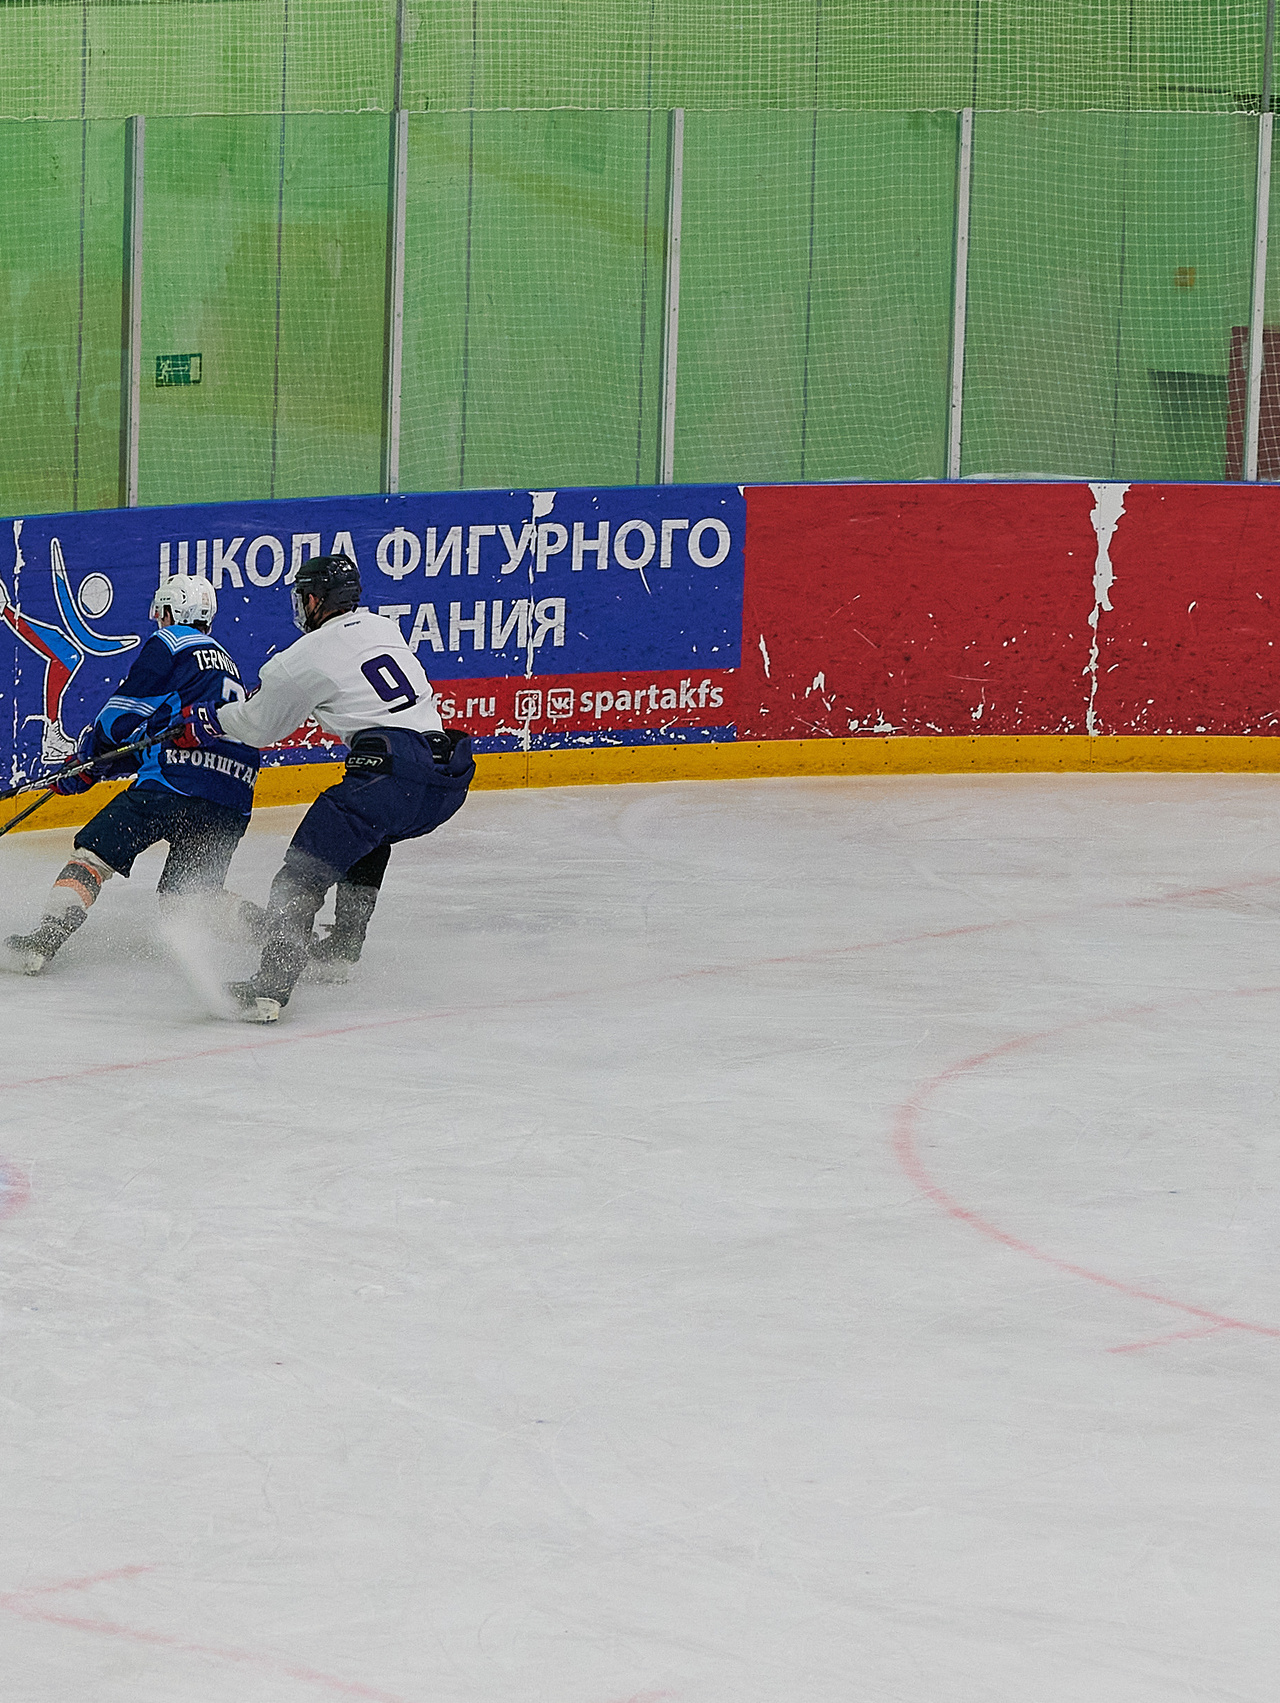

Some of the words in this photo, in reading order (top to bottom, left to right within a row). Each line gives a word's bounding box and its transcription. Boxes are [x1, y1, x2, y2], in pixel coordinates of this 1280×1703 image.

[375, 517, 731, 581] ФИГУРНОГО
[357, 597, 566, 655] ТАНИЯ
[360, 653, 419, 714] 9
[431, 692, 496, 719] fs.ru
[579, 680, 724, 718] spartakfs
[347, 757, 378, 767] CCM
